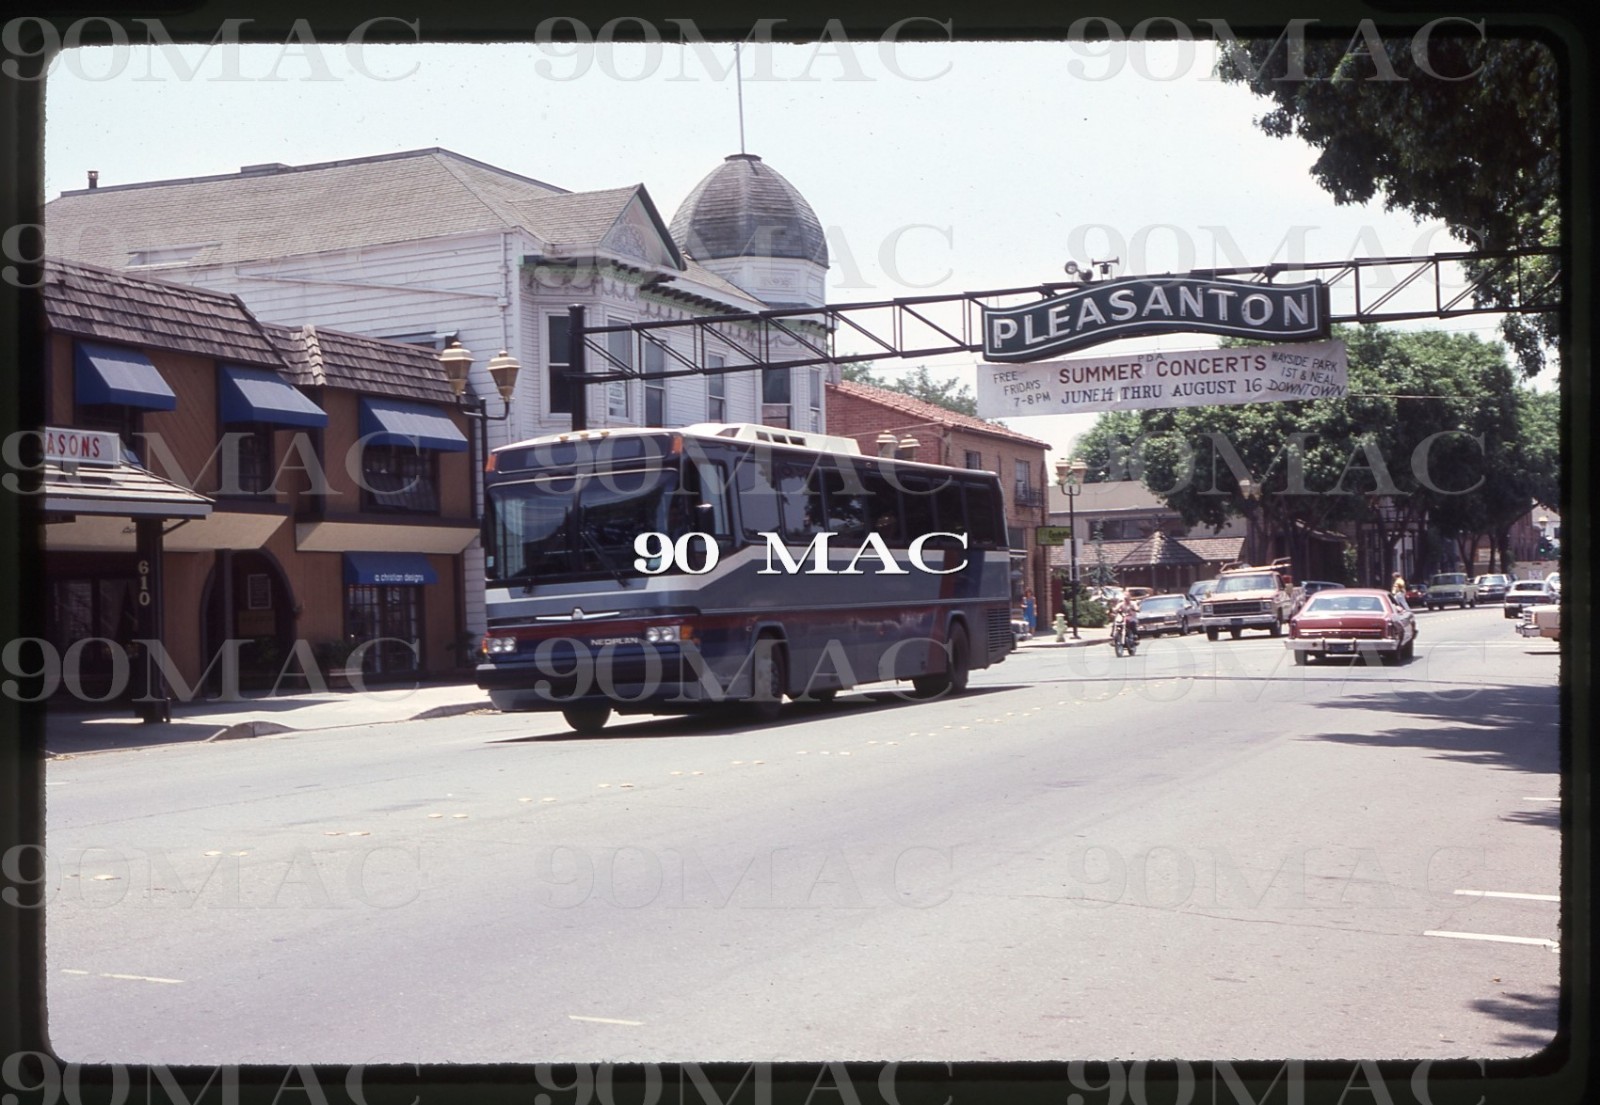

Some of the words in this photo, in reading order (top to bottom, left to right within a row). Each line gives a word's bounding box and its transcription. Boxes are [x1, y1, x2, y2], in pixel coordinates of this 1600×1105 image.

[993, 285, 1309, 348] PLEASANTON
[1058, 363, 1143, 384] SUMMER
[1156, 355, 1267, 377] CONCERTS
[1271, 352, 1310, 367] WAYSIDE
[1312, 359, 1337, 372] PARK
[993, 370, 1018, 384] FREE
[1003, 379, 1041, 396] FRIDAYS
[1266, 379, 1345, 396] DOWNTOWN
[1310, 371, 1335, 386] NEAL
[1121, 384, 1162, 400] THRU
[1172, 380, 1237, 397] AUGUST
[1244, 378, 1262, 393] 16
[47, 433, 99, 457] ASONS
[138, 560, 150, 606] 610
